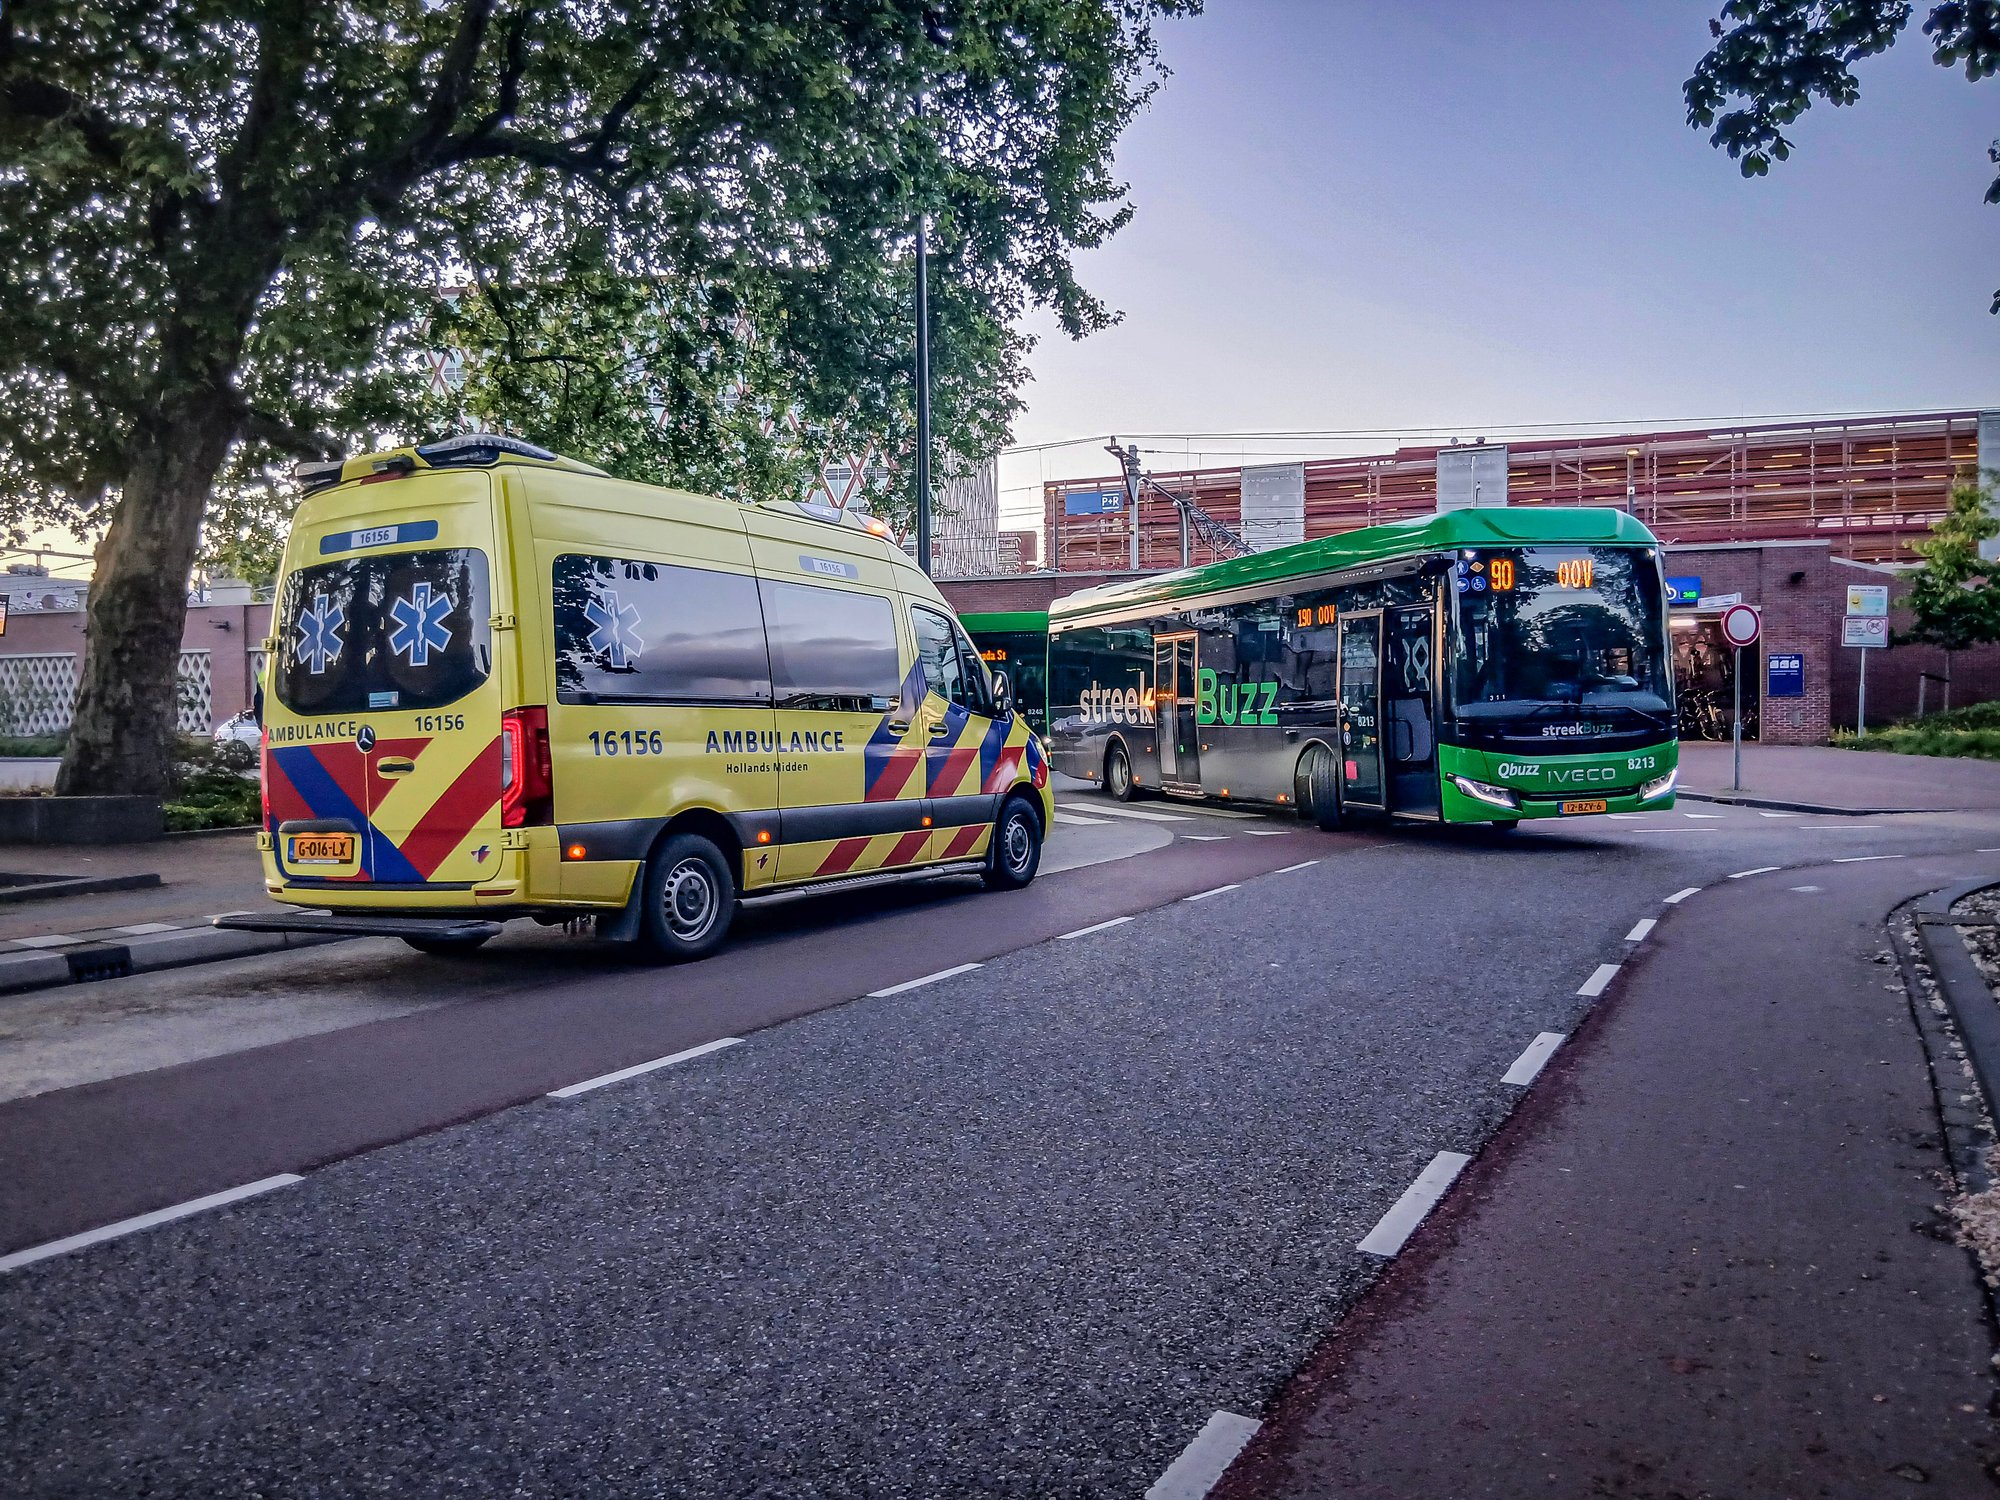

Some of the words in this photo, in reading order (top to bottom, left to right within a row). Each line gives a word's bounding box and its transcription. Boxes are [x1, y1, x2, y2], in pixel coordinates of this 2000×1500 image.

[1102, 496, 1119, 507] P+R
[360, 529, 390, 544] 16156
[820, 562, 841, 574] 16156
[1491, 560, 1513, 590] 90
[1297, 607, 1312, 628] 190
[997, 649, 1006, 660] St
[1079, 671, 1155, 724] streek
[1197, 668, 1279, 726] Buzz
[414, 714, 465, 732] 16156
[1357, 715, 1375, 727] 8213
[269, 720, 356, 743] AMBULANCE
[588, 730, 663, 756] 16156
[705, 730, 845, 753] AMBULANCE
[726, 763, 770, 774] Hollands
[773, 762, 808, 773] Midden
[1498, 763, 1541, 779] Qbuzz
[1627, 756, 1655, 770] 8213
[1547, 767, 1616, 783] IVECO
[298, 841, 346, 857] G-016-LX
